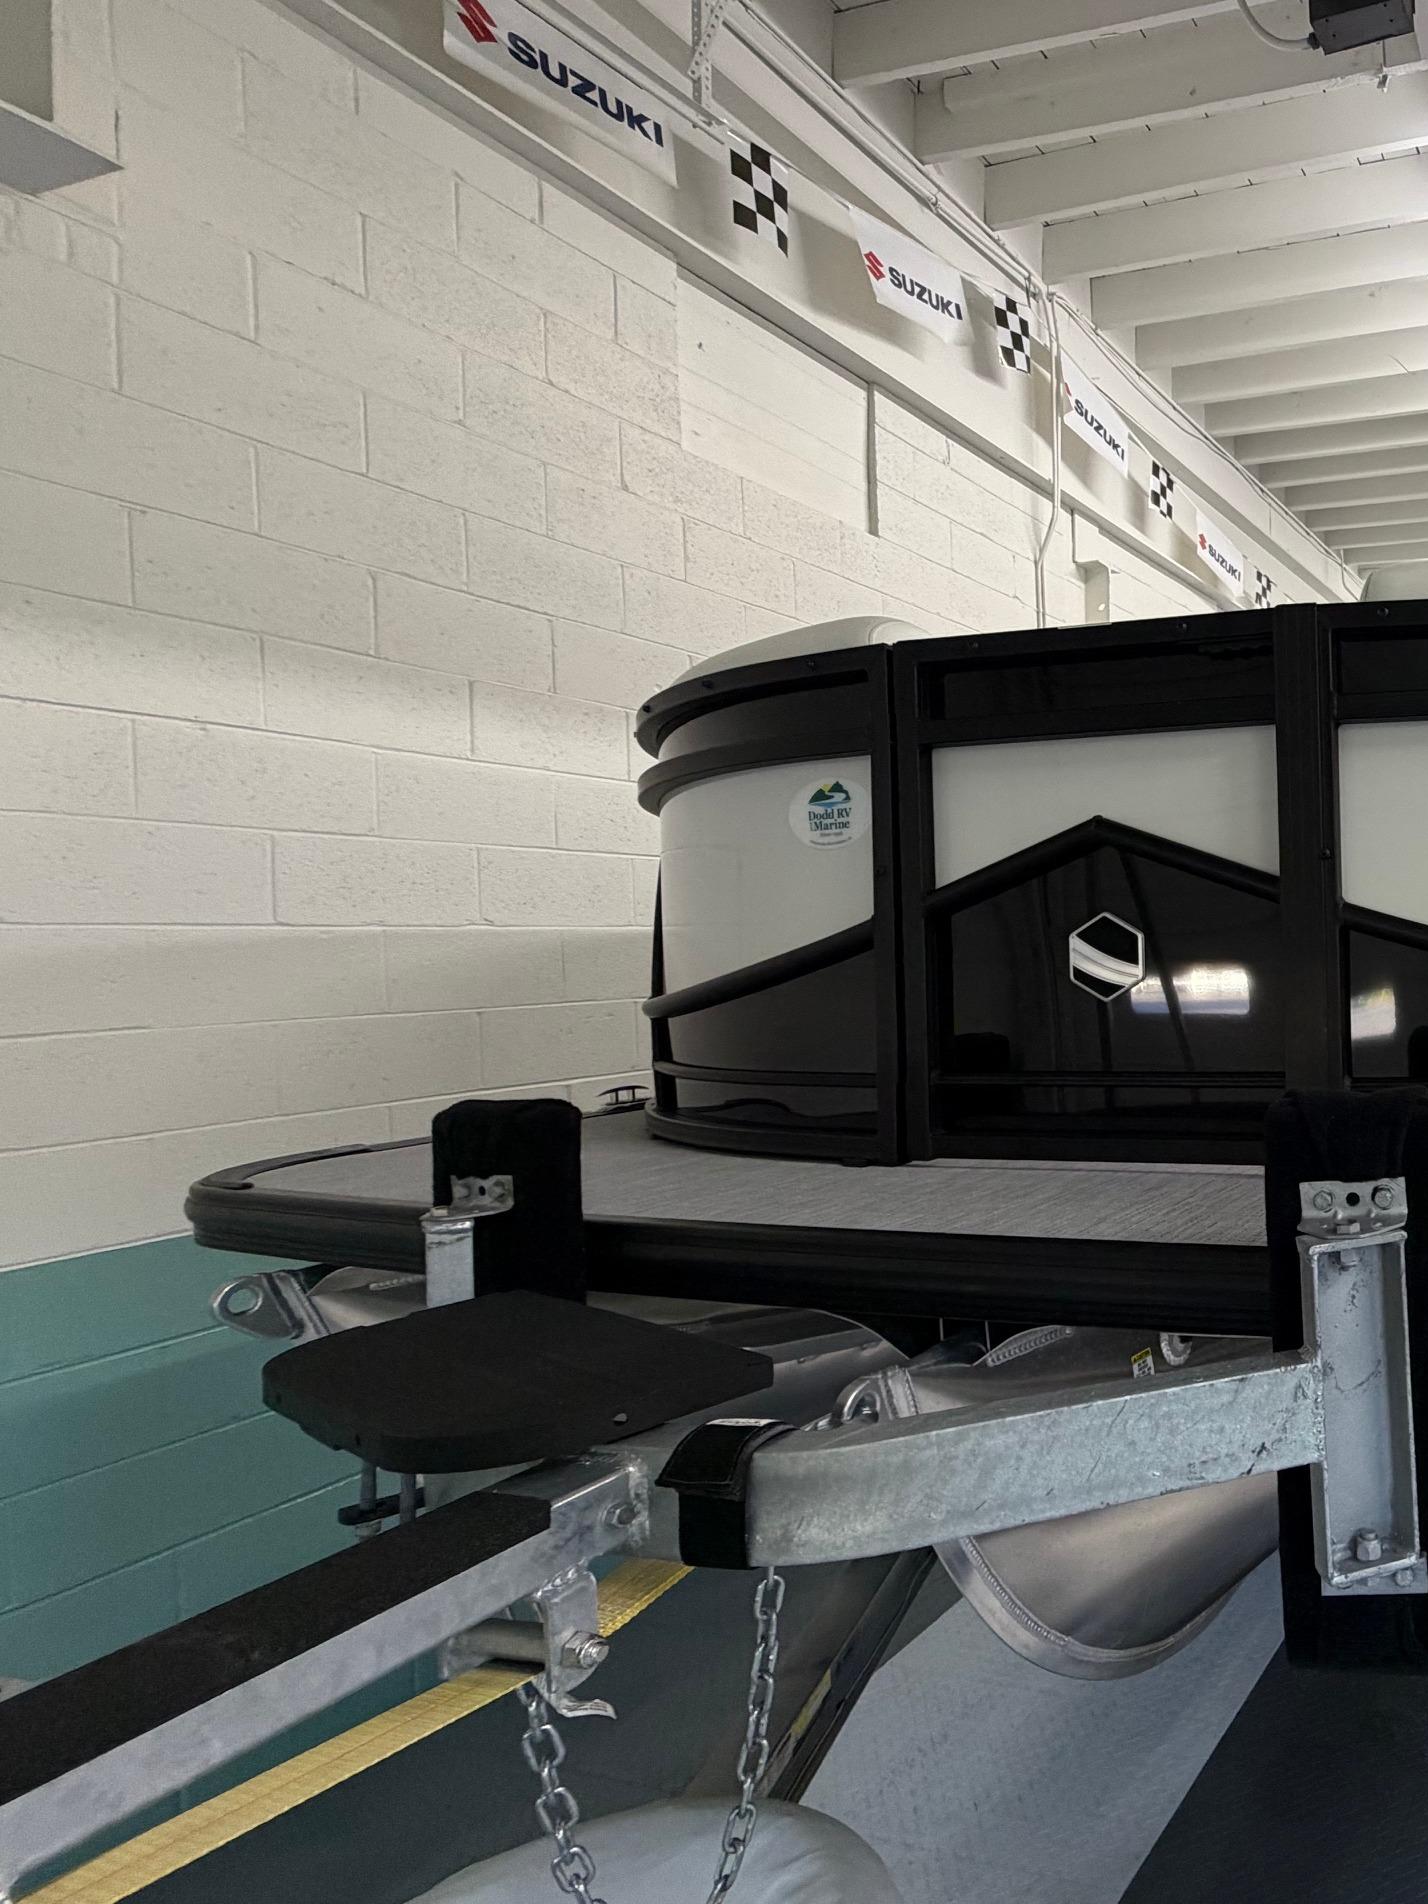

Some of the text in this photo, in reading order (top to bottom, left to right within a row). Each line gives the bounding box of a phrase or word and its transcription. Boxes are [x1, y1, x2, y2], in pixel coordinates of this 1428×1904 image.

[507, 31, 664, 148] SUZUKI
[888, 266, 963, 321] SUZUKI
[1074, 398, 1125, 461] SUZUKI
[1208, 543, 1242, 582] SUZUKI
[808, 807, 852, 821] Dodd RV
[813, 818, 851, 831] Marine
